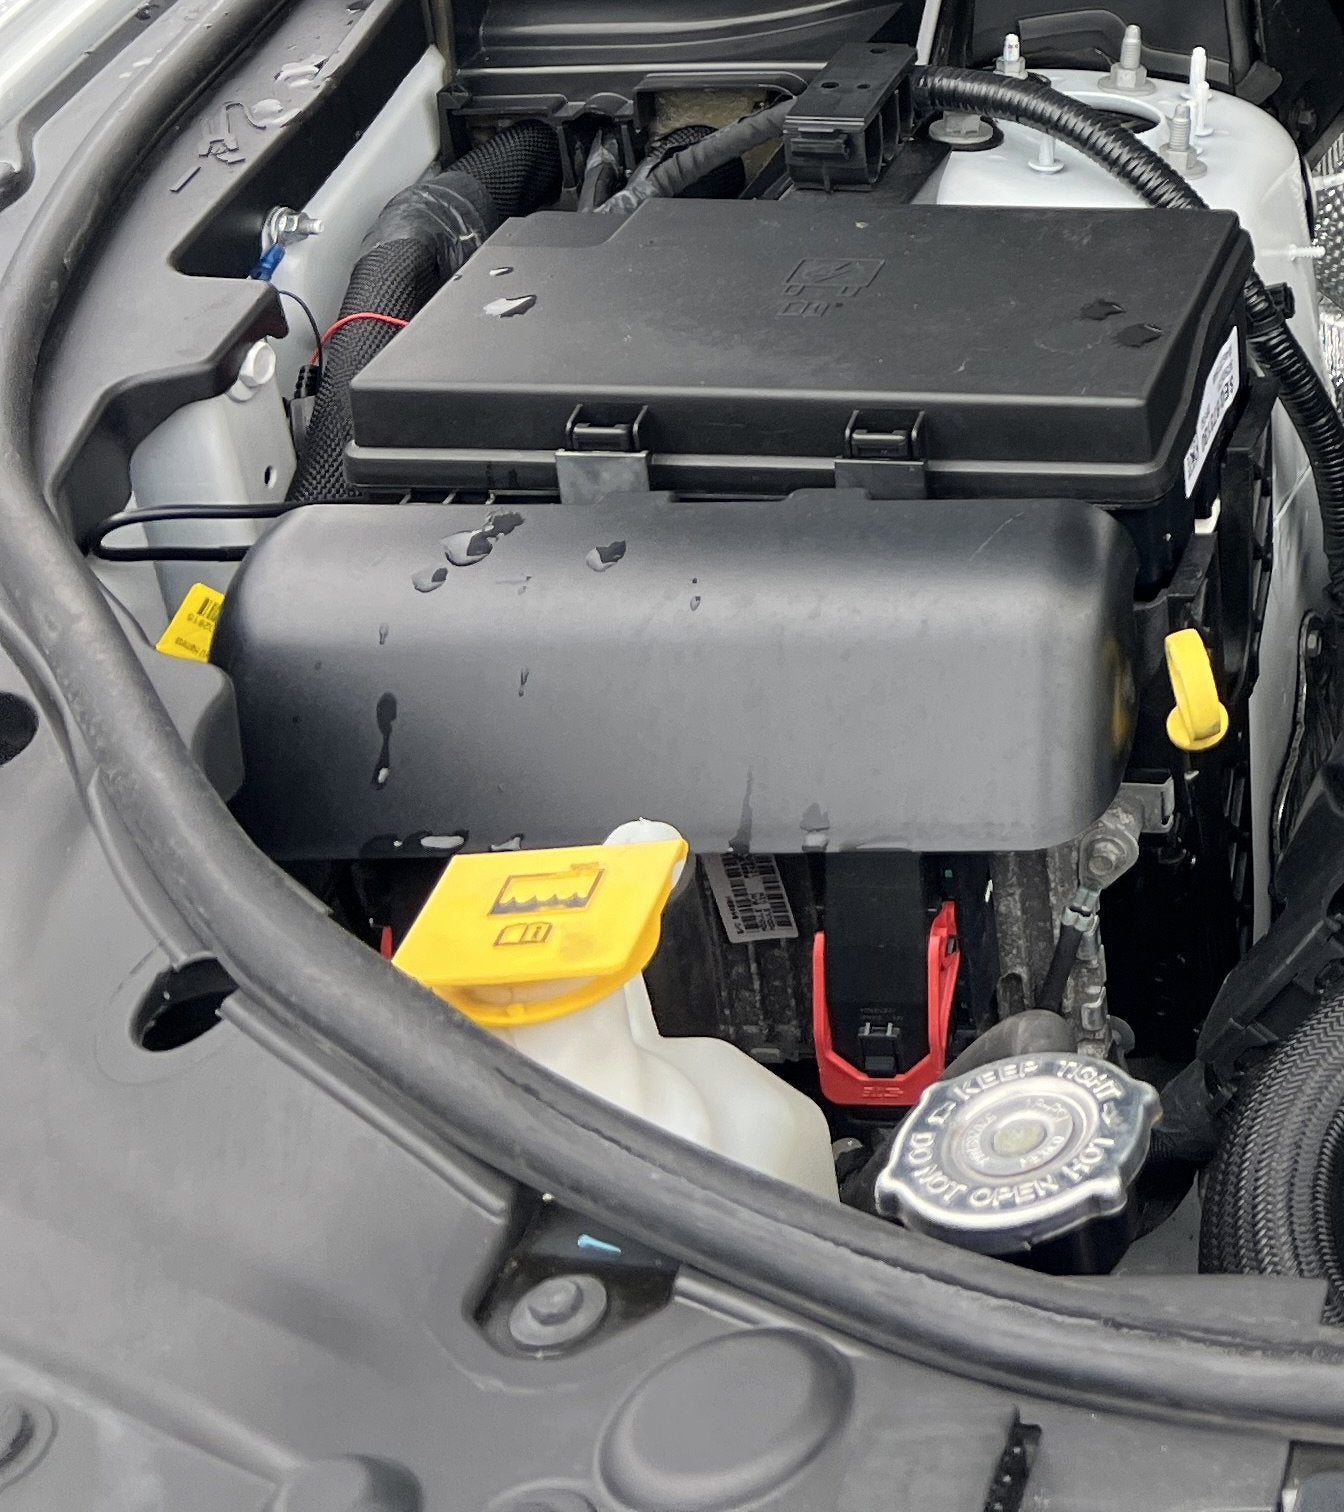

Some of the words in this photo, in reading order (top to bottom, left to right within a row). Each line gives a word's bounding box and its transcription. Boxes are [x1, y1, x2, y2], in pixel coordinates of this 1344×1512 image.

[953, 1059, 1039, 1101] KEEP
[1055, 1059, 1124, 1102] TIGHT
[907, 1131, 935, 1166] DO
[913, 1163, 969, 1203] NOT
[968, 1173, 1060, 1207] OPEN
